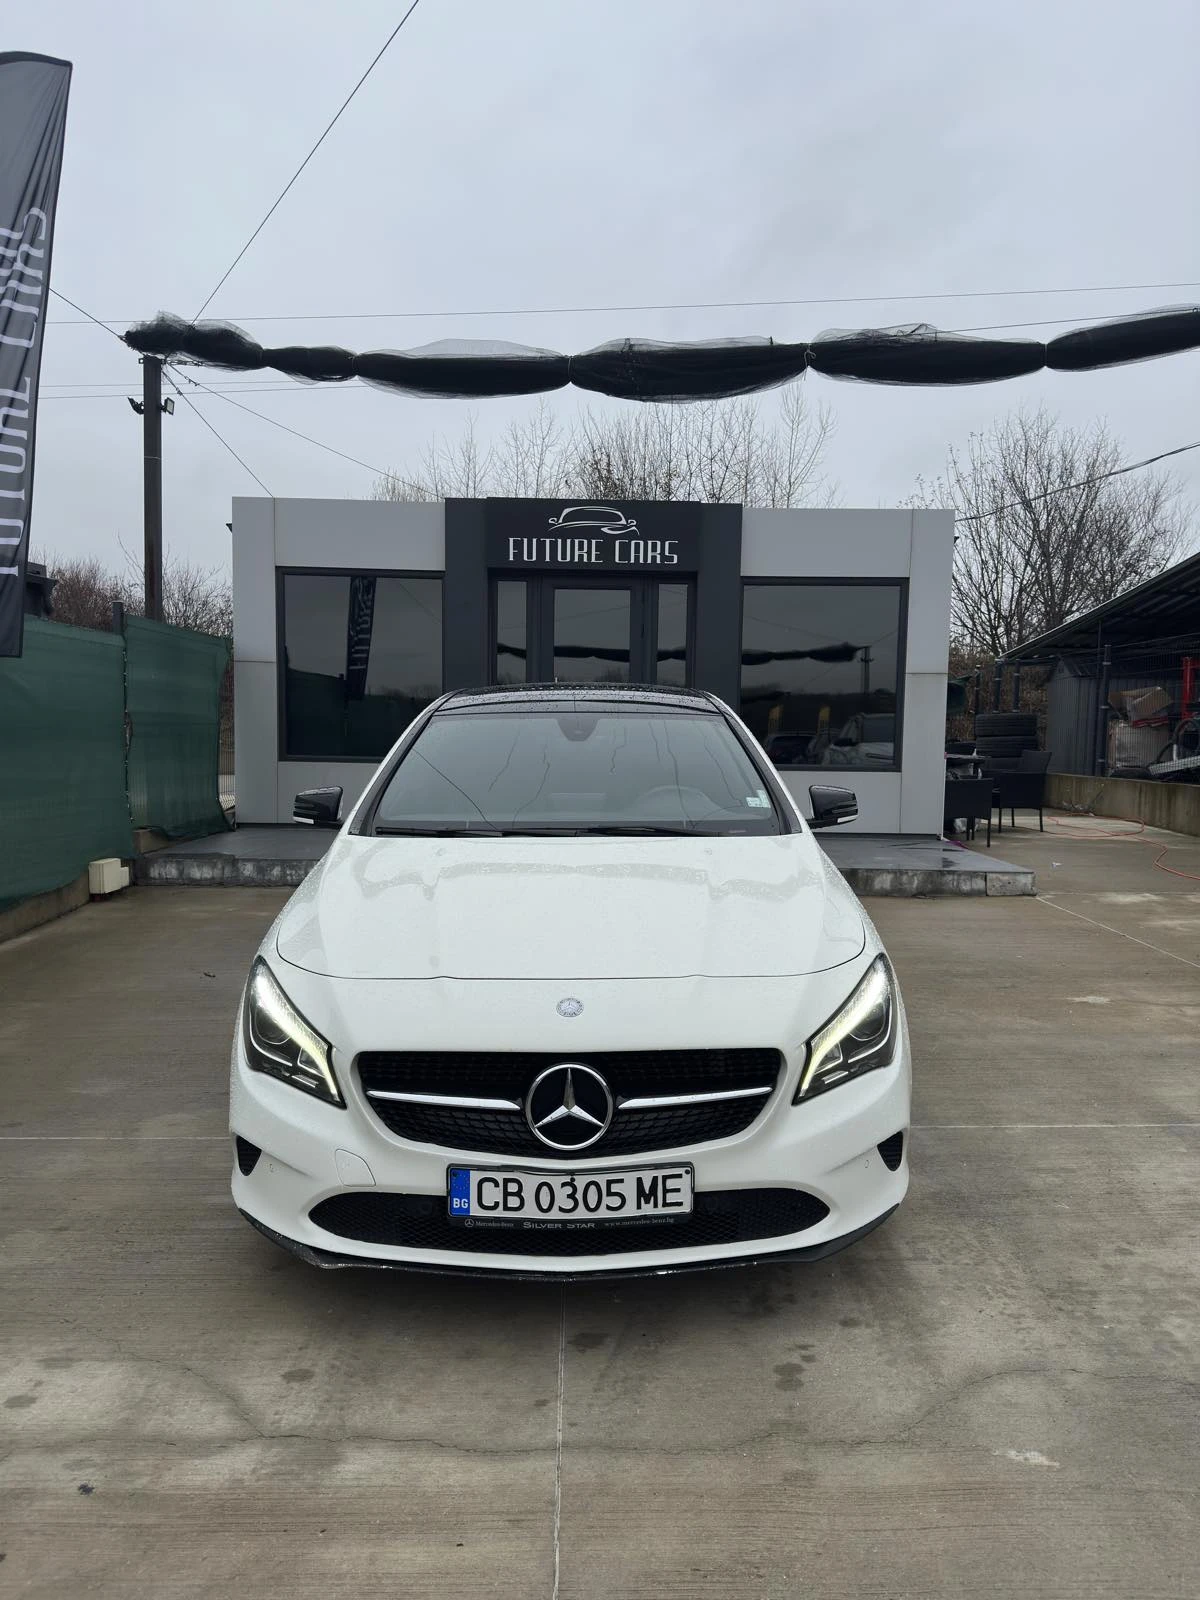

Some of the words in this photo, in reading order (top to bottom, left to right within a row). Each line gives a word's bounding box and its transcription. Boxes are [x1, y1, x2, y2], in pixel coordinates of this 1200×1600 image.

[508, 537, 604, 563] FUTURE
[614, 539, 679, 564] CARS
[452, 1197, 469, 1209] BG
[477, 1176, 525, 1212] CB
[534, 1178, 627, 1214] 0305
[636, 1173, 684, 1210] ME
